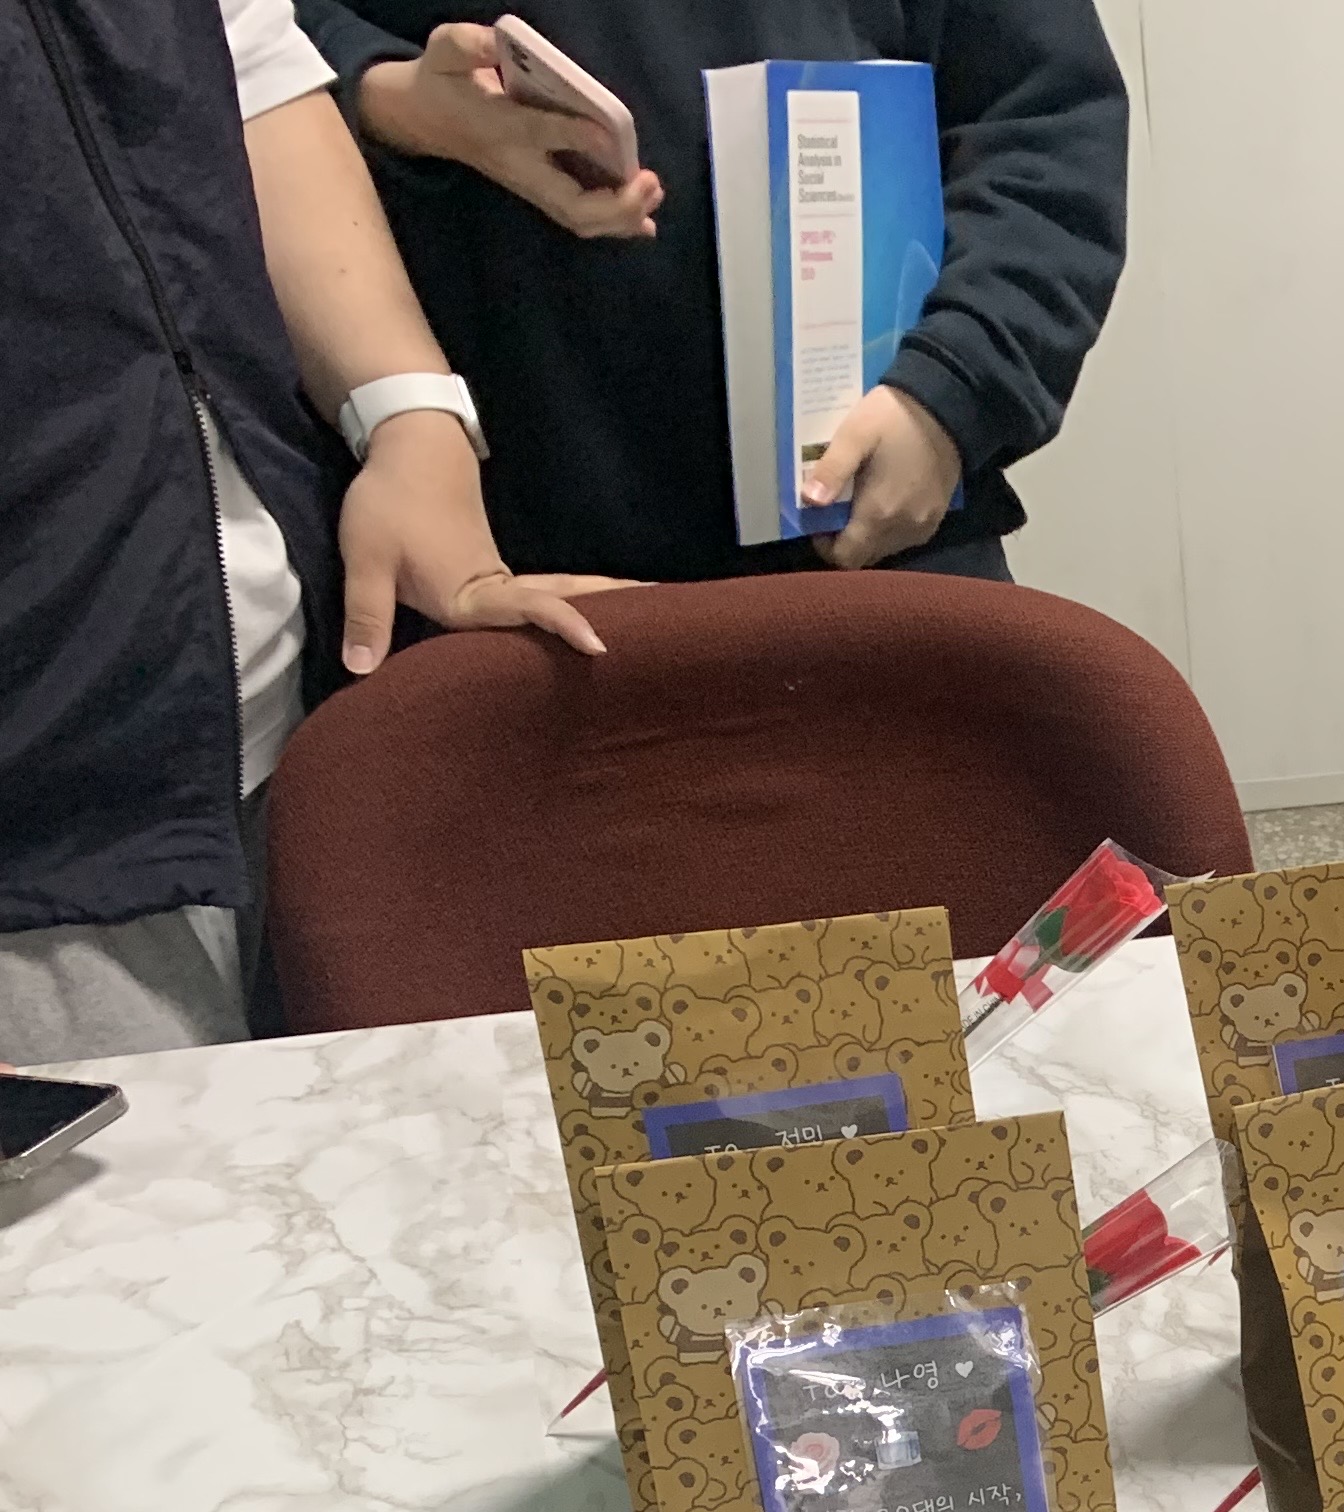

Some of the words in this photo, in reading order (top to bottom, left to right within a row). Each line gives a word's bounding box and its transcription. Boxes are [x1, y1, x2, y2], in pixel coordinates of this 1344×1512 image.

[797, 134, 838, 149] Statistical
[798, 152, 833, 168] Analysis
[798, 170, 824, 185] Social
[878, 1360, 939, 1391] 나영
[966, 1482, 1023, 1508] 시작,
